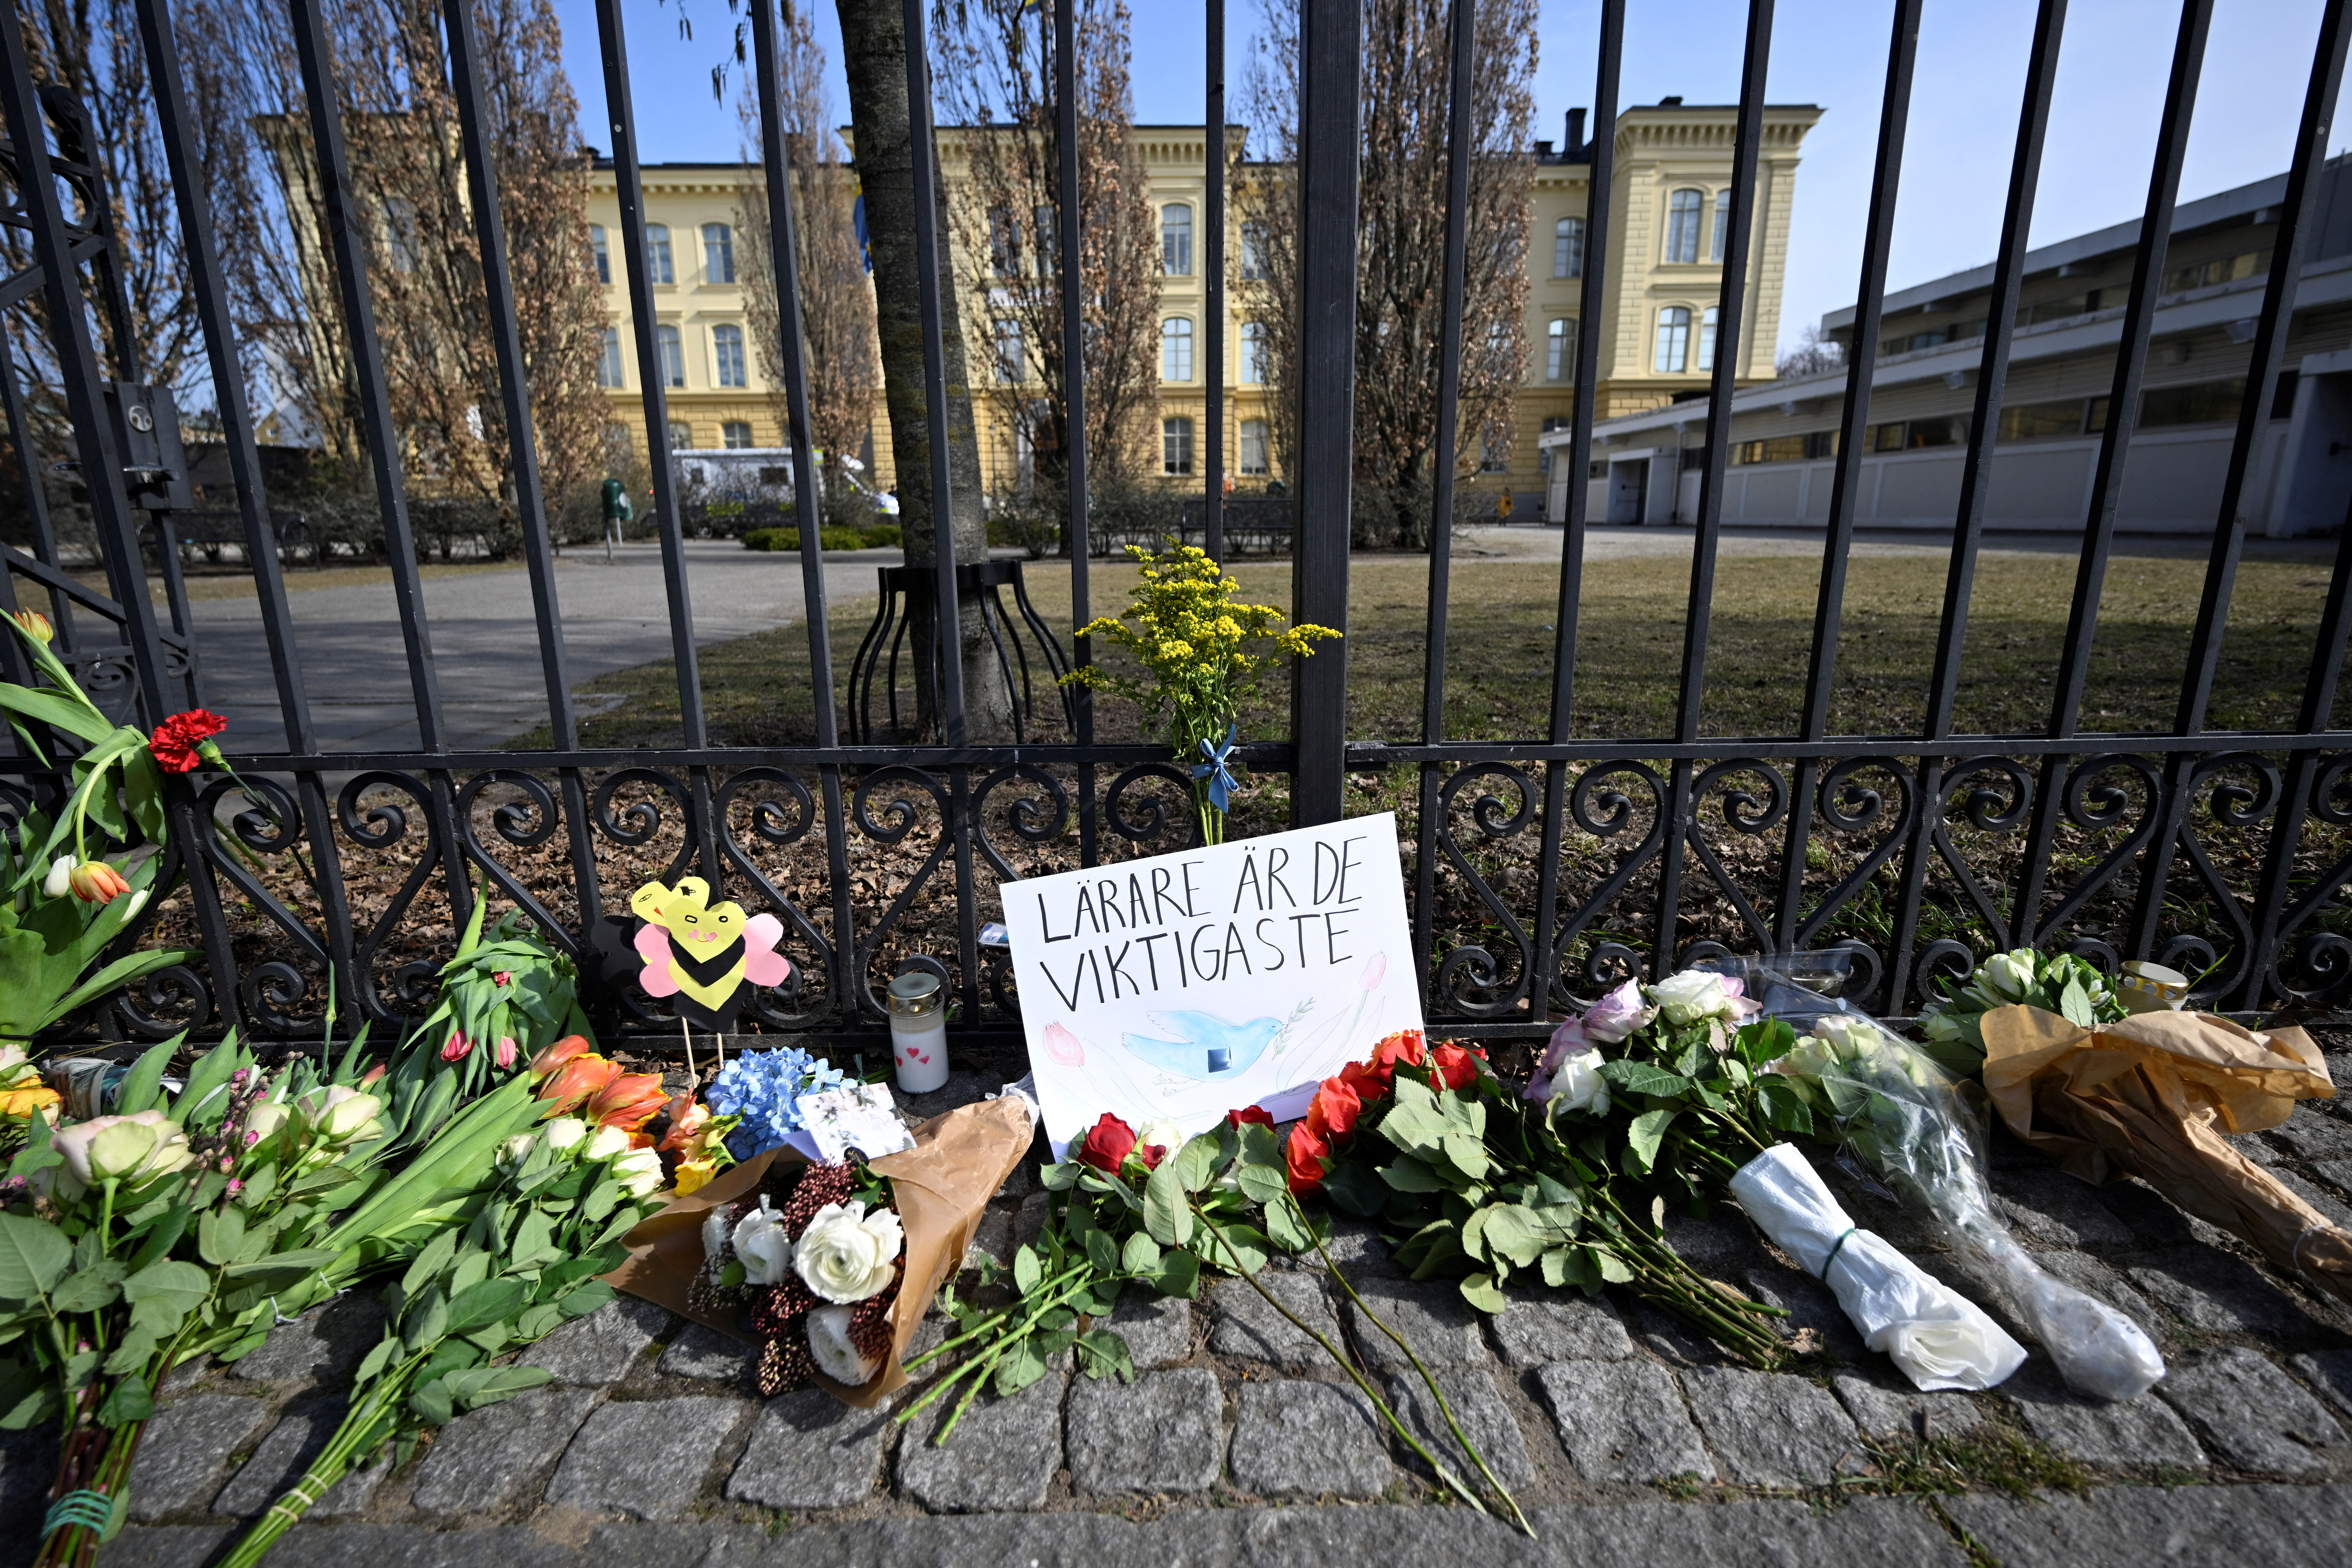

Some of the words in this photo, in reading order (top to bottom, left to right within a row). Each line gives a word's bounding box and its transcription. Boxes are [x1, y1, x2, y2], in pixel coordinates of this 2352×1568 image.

[1038, 861, 1212, 943] LÄRARE
[1233, 846, 1297, 914] ÄR
[1313, 836, 1367, 905] DE
[1039, 909, 1360, 1012] VIKTIGASTE
